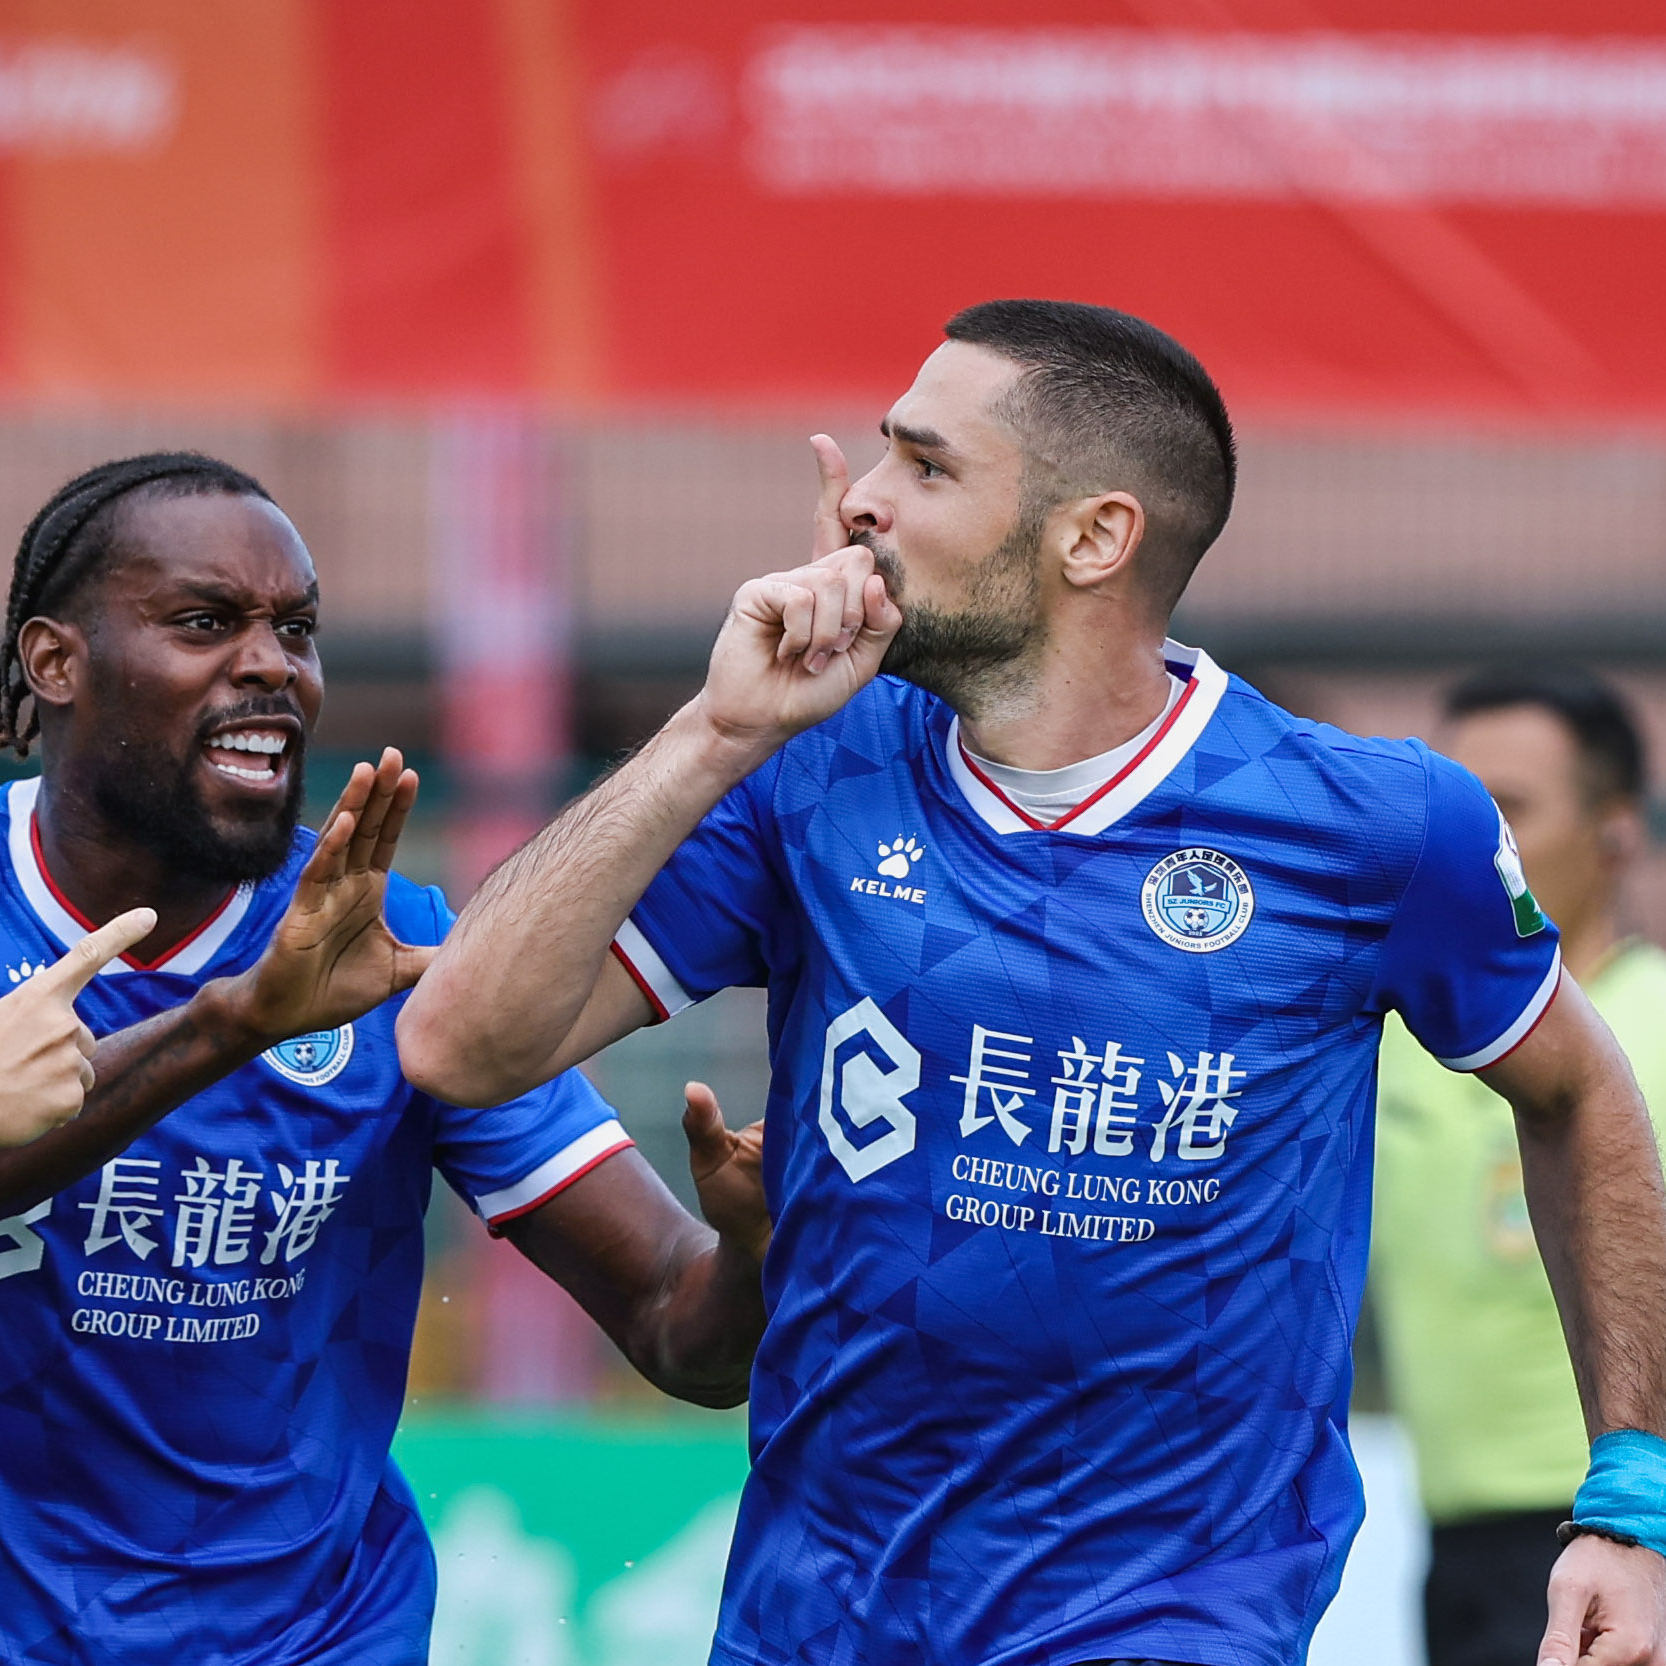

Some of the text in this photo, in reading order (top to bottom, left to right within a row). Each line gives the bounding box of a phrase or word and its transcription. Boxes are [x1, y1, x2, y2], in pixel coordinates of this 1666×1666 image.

[850, 877, 927, 904] KELME
[1179, 898, 1214, 907] JUNIORS
[1145, 893, 1249, 949] SHENZHEN JUNIORS FOOTBALL CLUB
[949, 1023, 1247, 1163] 長龍港
[951, 1154, 1221, 1206] CHEUNG LUNG KONG
[78, 1156, 350, 1268] 長龍港
[945, 1194, 1156, 1243] GROUP LIMITED
[77, 1267, 306, 1307] CHEUNG LUNG KONG
[71, 1307, 261, 1343] GROUP LIMITED
